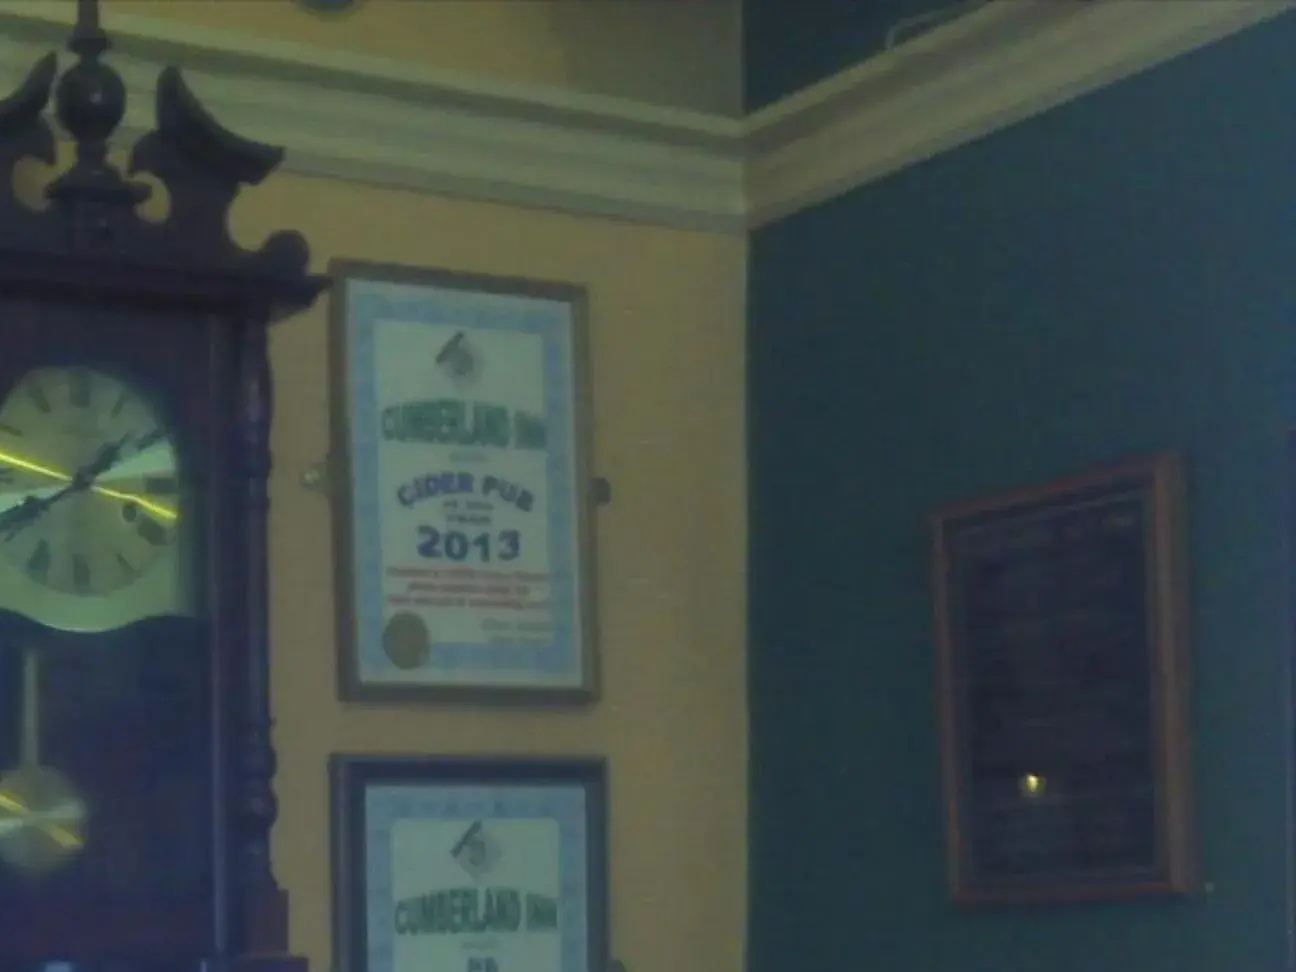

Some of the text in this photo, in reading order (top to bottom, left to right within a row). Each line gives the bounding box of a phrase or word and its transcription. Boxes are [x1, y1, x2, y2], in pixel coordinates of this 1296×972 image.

[482, 475, 535, 513] PUB
[416, 524, 521, 563] 2013
[394, 887, 520, 936] CUMBERLAND
